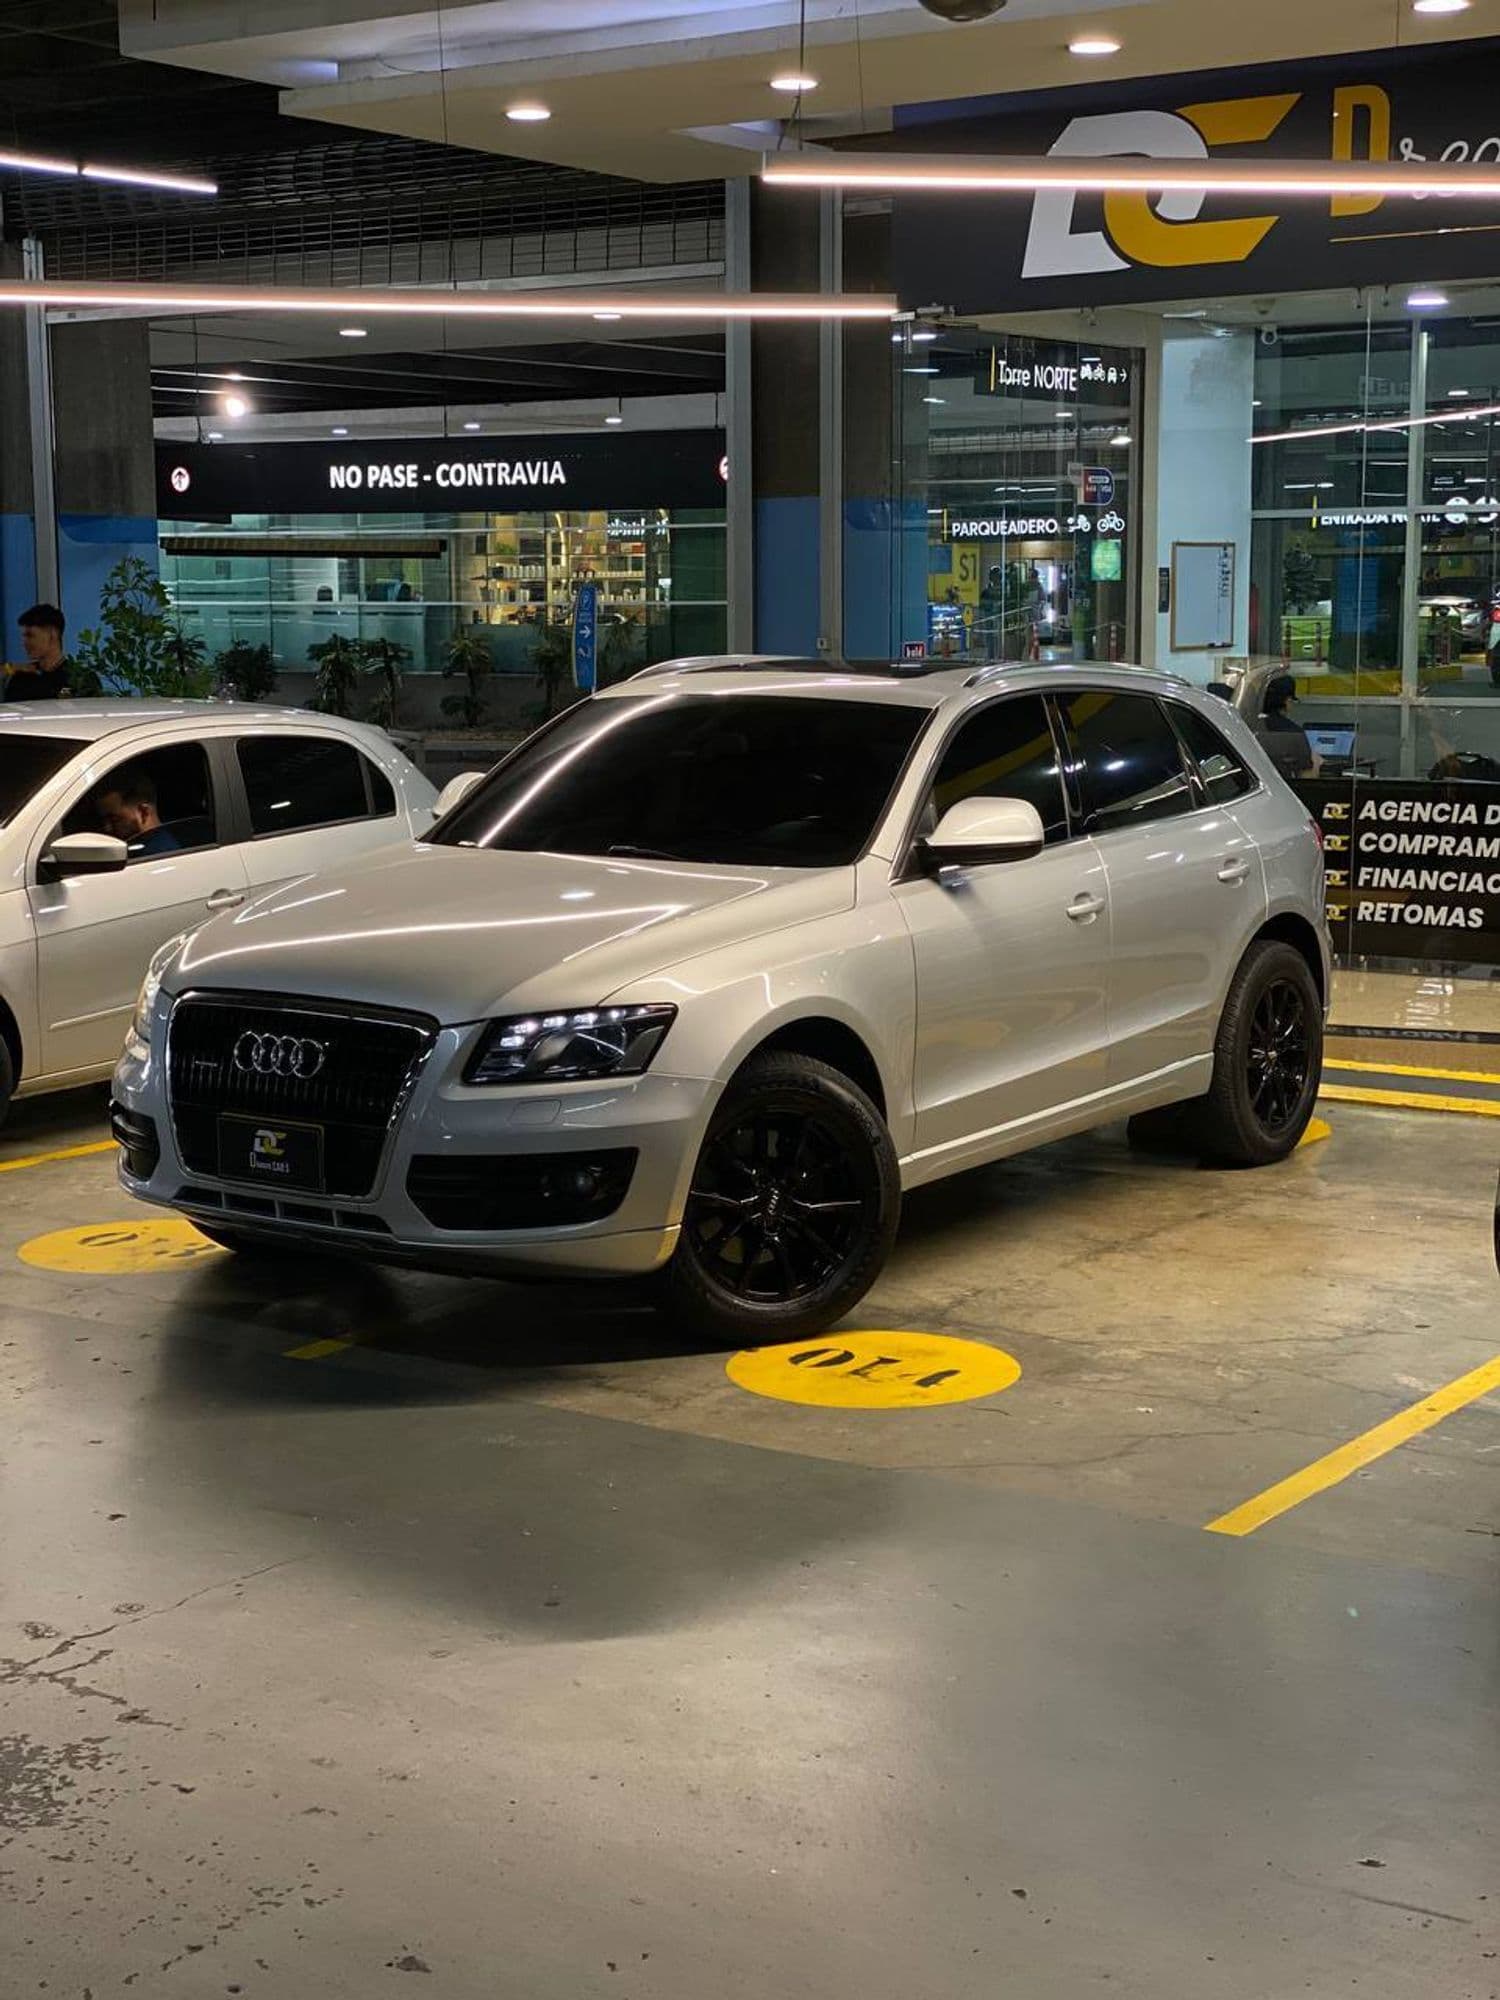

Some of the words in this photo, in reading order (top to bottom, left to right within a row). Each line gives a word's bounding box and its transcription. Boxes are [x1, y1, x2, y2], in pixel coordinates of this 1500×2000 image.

[998, 360, 1031, 386] Torre
[1034, 365, 1077, 391] NORTE
[329, 465, 362, 488] NO
[367, 464, 418, 488] PASE
[435, 460, 567, 487] CONTRAVIA
[951, 518, 1059, 537] PARQUEADERO
[959, 553, 977, 582] S1
[1358, 800, 1478, 825] AGENCIA
[1356, 901, 1485, 929] RETOMAS
